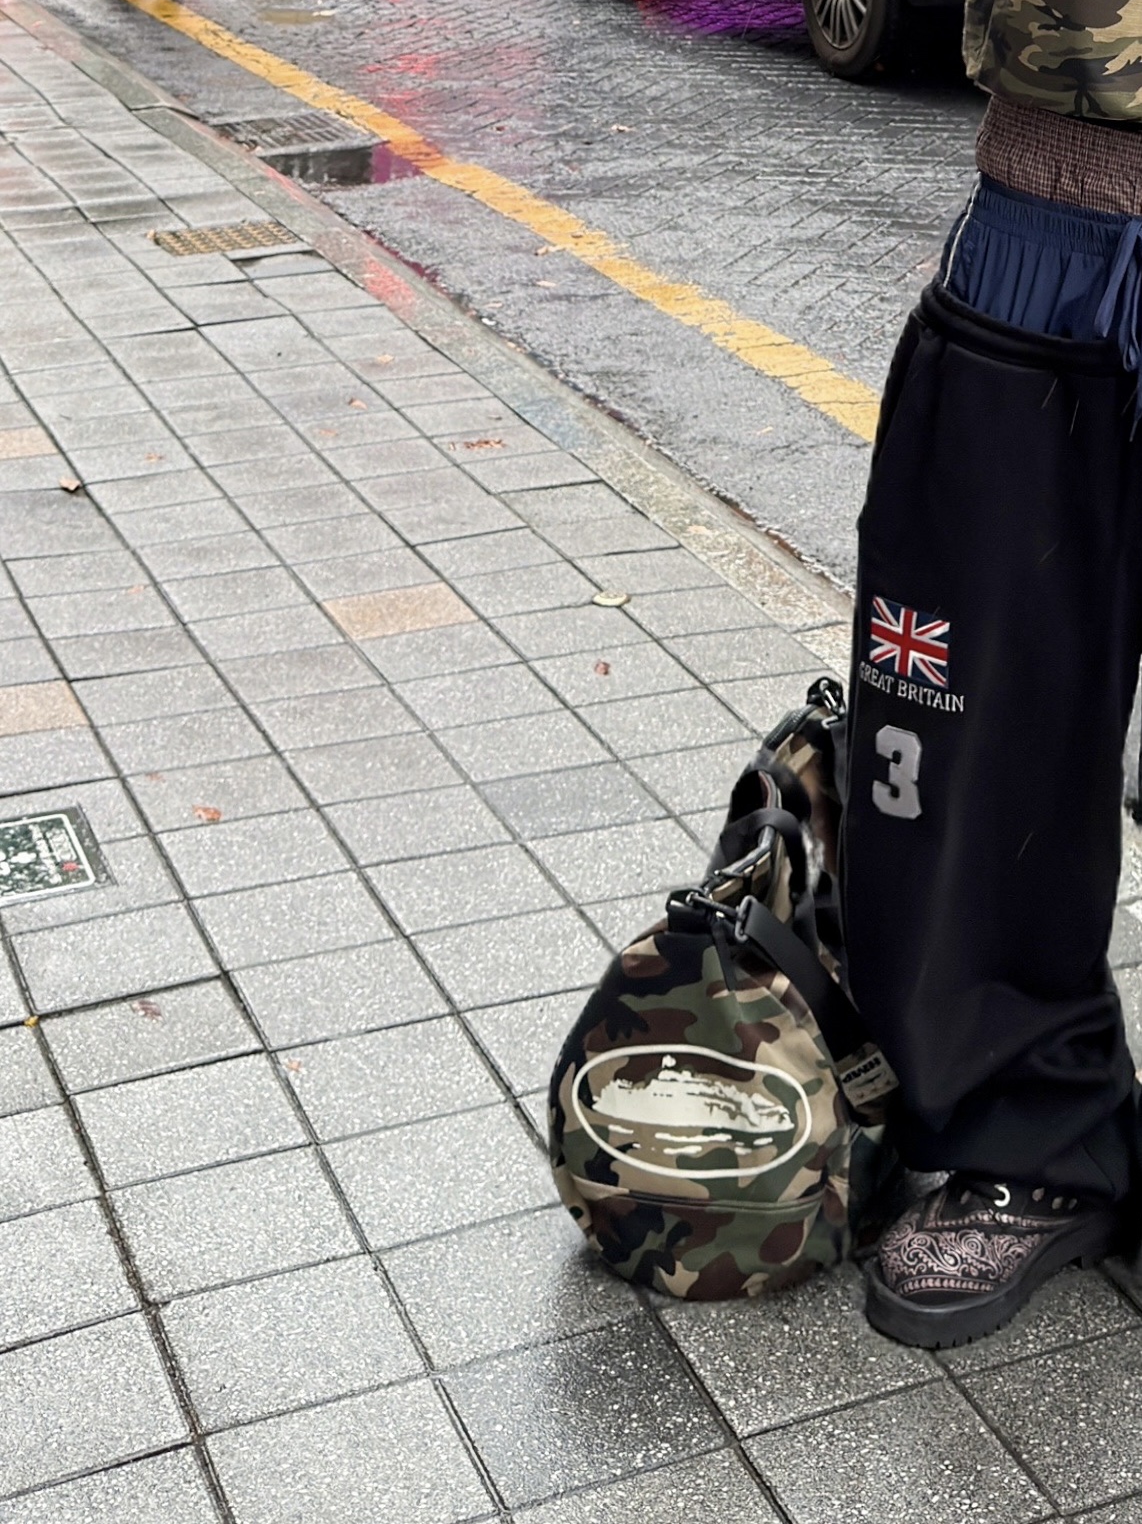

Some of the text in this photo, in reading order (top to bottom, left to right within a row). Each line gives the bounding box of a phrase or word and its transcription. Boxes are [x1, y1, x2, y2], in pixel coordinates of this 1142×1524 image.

[859, 661, 965, 713] GREAT BRITAIN
[872, 724, 923, 820] 3
